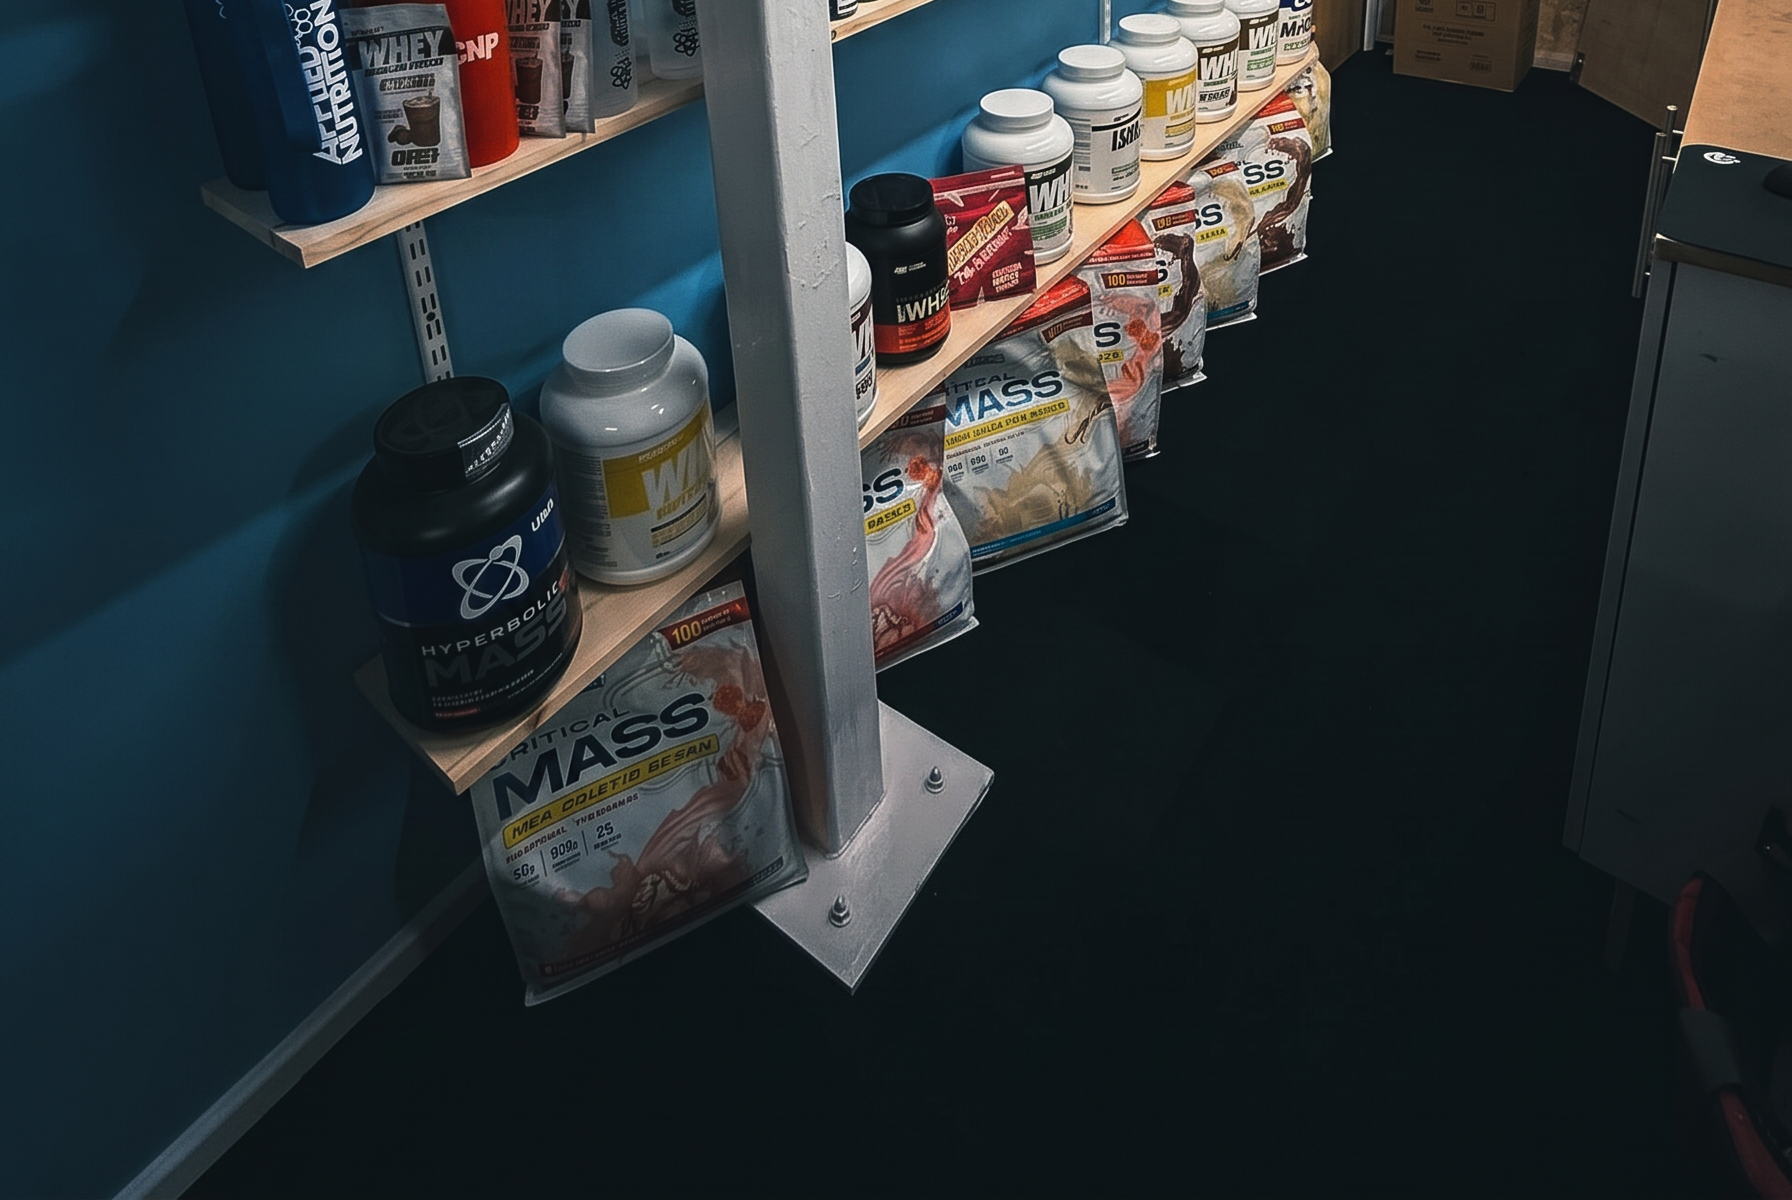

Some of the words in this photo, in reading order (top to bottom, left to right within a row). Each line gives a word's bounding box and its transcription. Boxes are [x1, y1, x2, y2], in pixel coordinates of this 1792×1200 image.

[358, 29, 445, 68] WHEY
[454, 31, 500, 66] CNP
[945, 370, 1064, 428] MASS
[421, 580, 560, 658] HYPERBOLIC
[423, 597, 567, 689] MASS
[671, 620, 702, 645] 100
[491, 693, 710, 822] MASS
